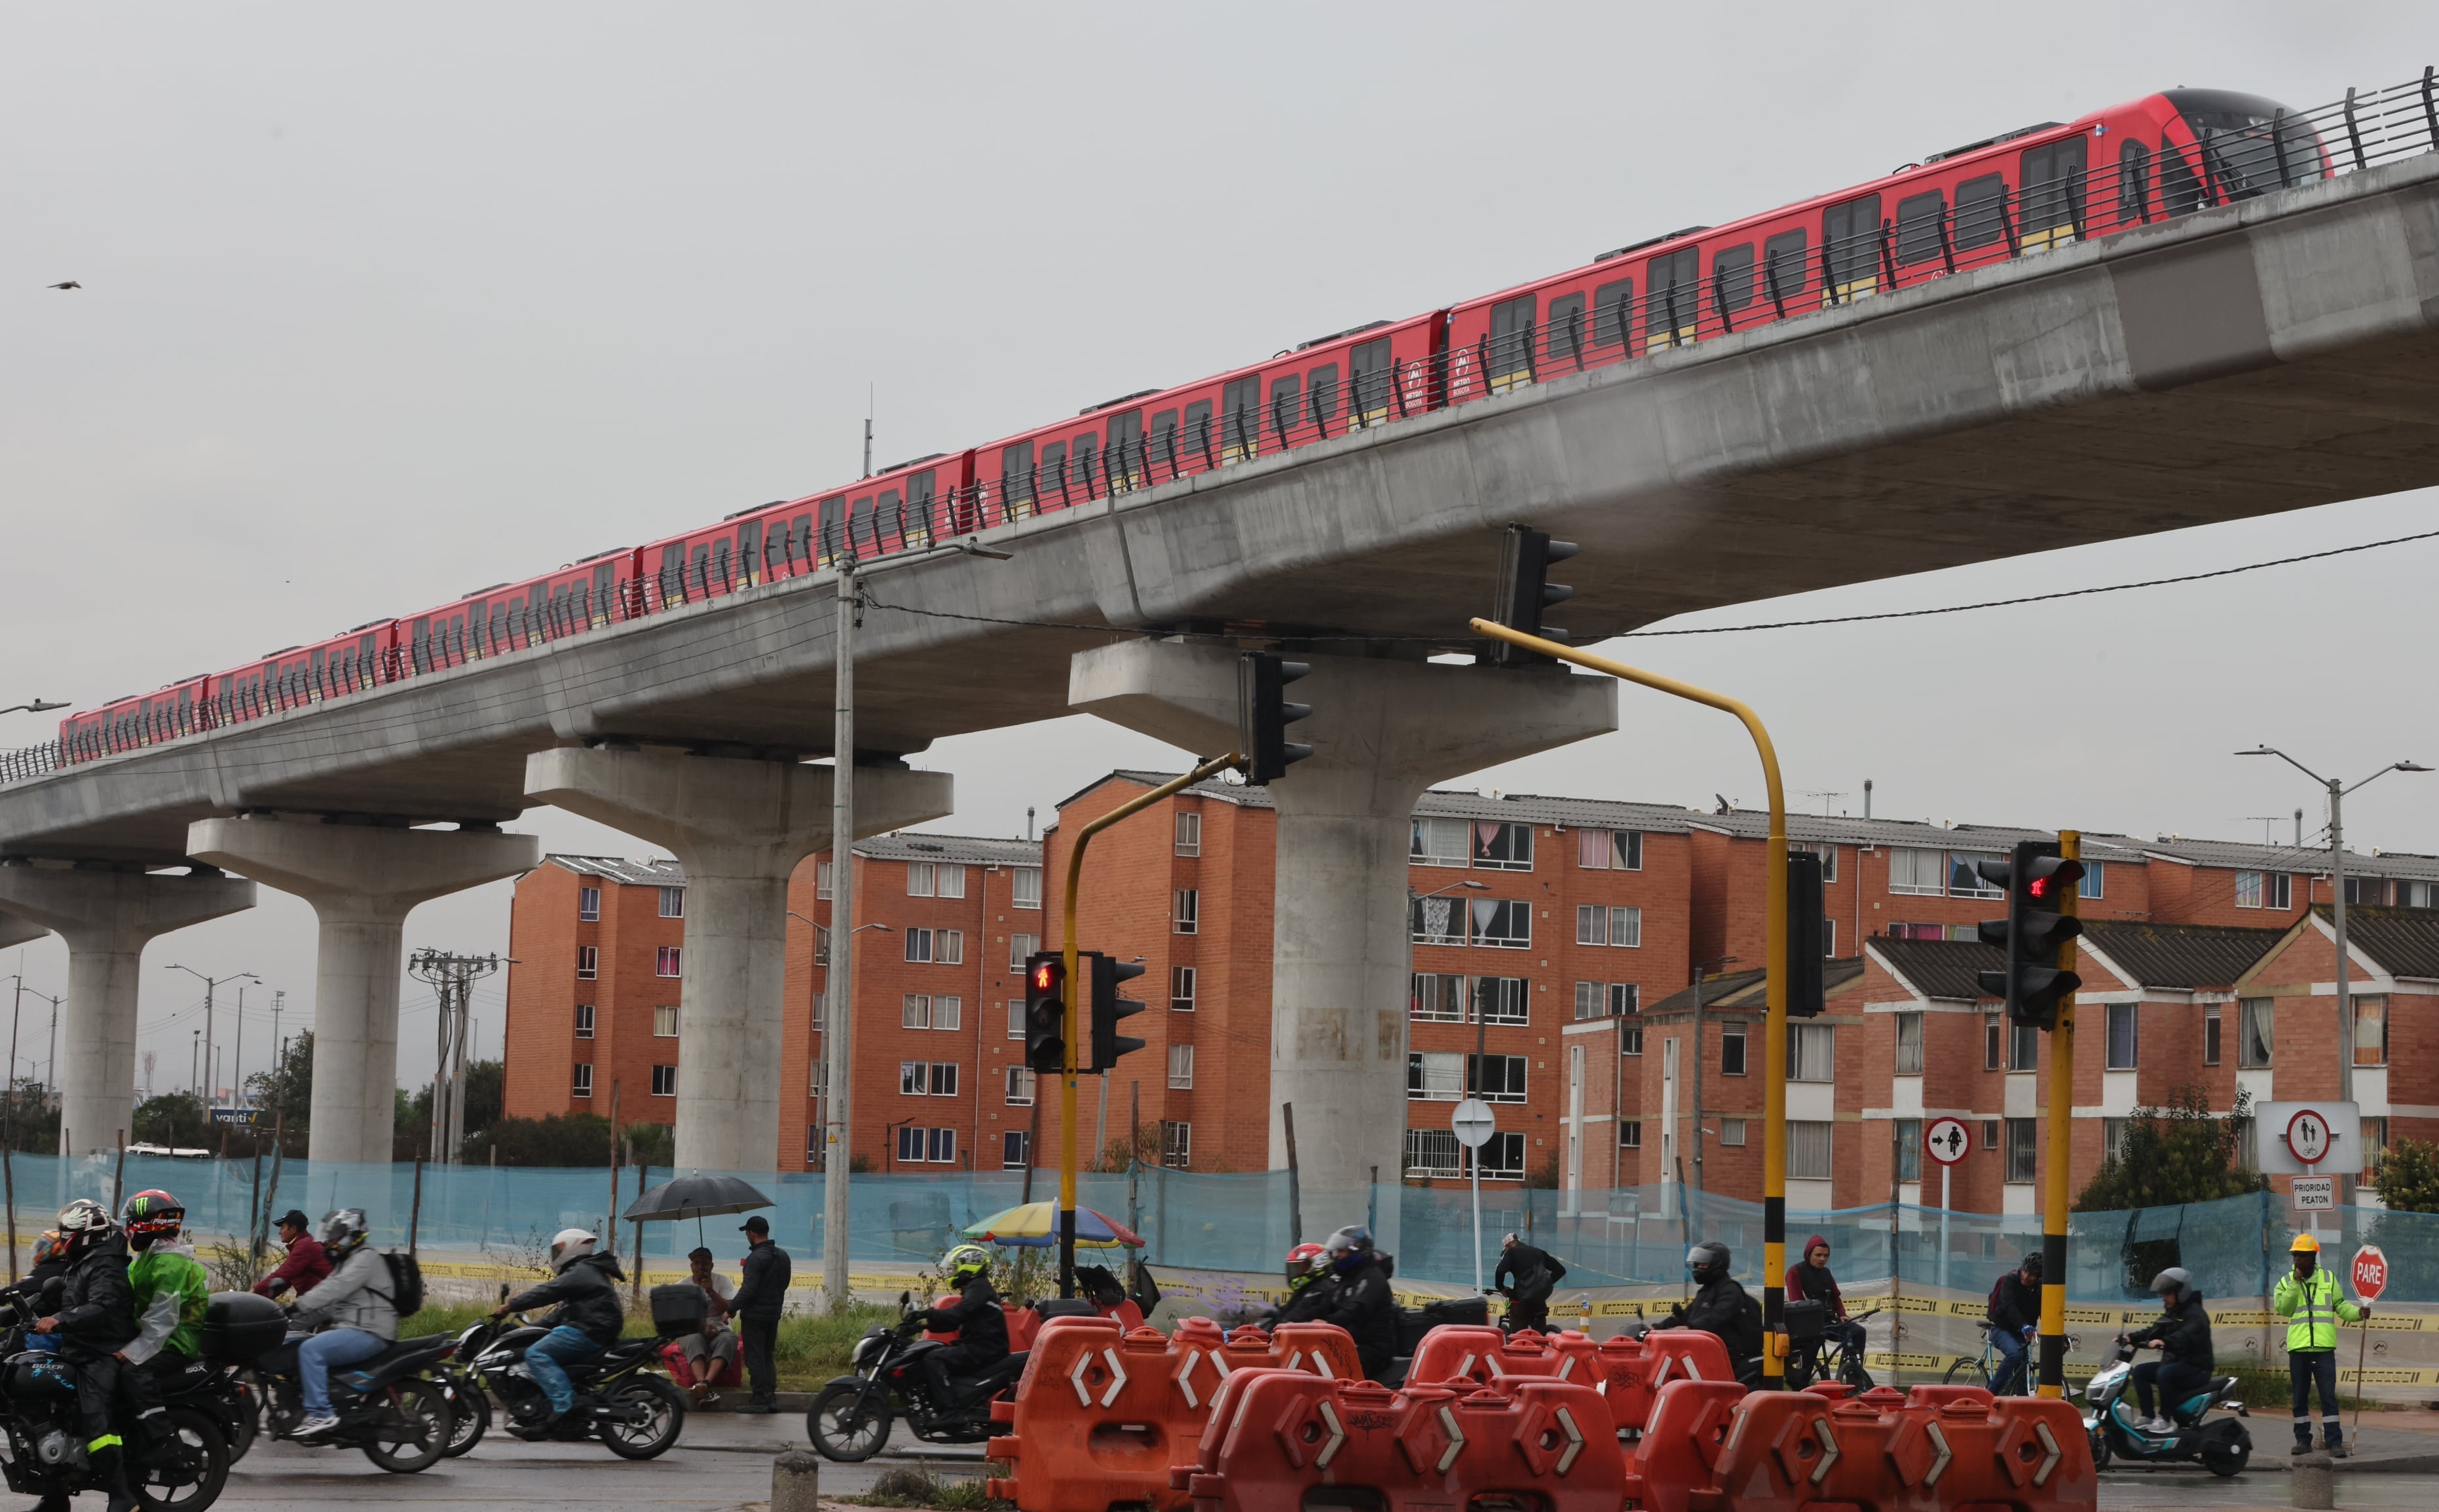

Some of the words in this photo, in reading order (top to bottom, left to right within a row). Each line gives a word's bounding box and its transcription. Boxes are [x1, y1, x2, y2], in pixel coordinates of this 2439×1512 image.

[1453, 377, 1470, 387] METRO
[1406, 390, 1423, 400] METRO
[216, 1113, 247, 1123] vanti
[2294, 1183, 2330, 1192] PRIORIDAD
[2356, 1263, 2382, 1285] PARE
